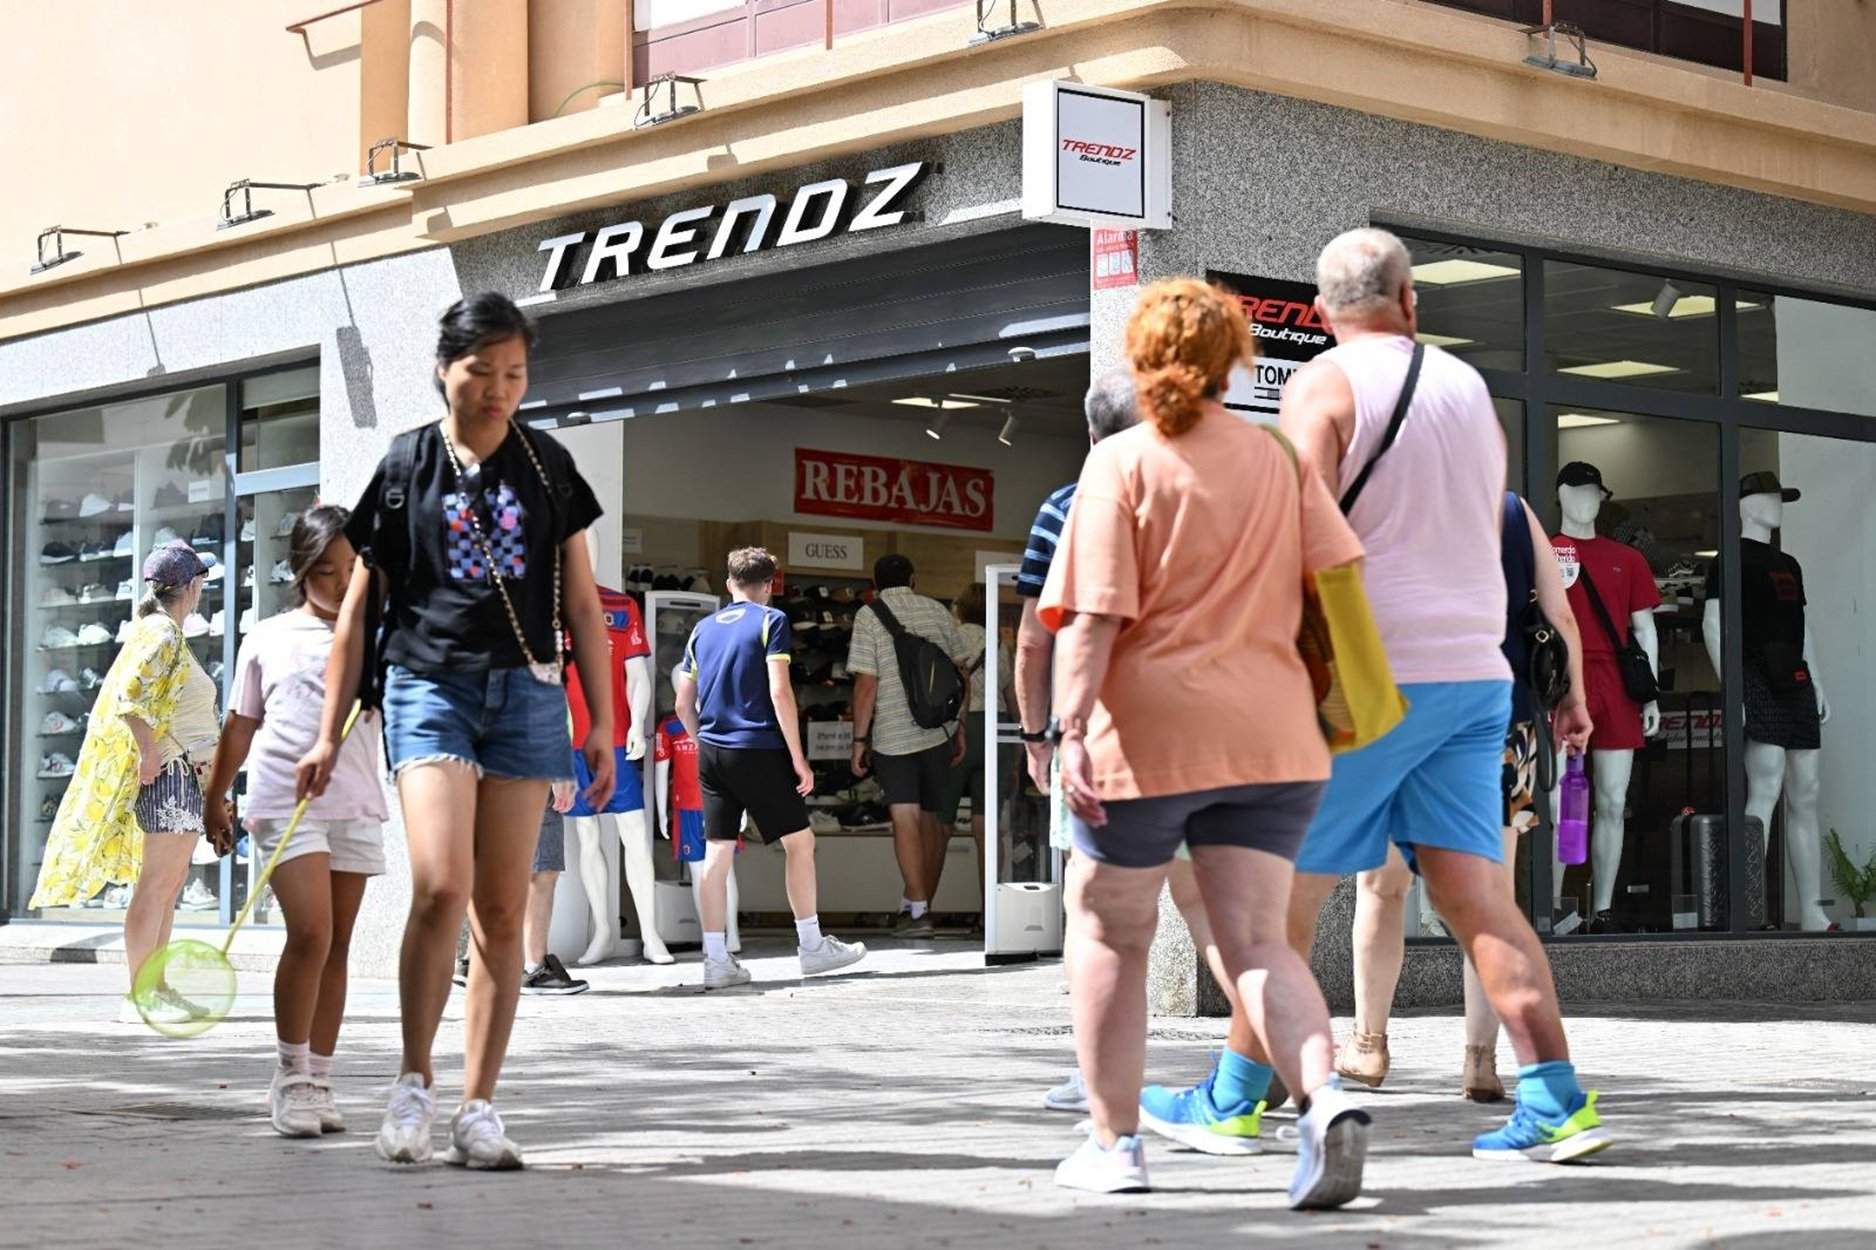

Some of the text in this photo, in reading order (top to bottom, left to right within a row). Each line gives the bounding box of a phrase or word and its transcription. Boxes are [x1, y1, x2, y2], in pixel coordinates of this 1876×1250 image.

[1063, 139, 1136, 160] TRENDZ
[1079, 154, 1122, 167] Boutique
[537, 160, 924, 292] TRENDZ
[1236, 294, 1324, 329] REND
[1248, 322, 1329, 346] Boutique
[1254, 364, 1298, 387] TOM
[801, 459, 986, 518] REBAJAS
[805, 543, 848, 560] GUESS
